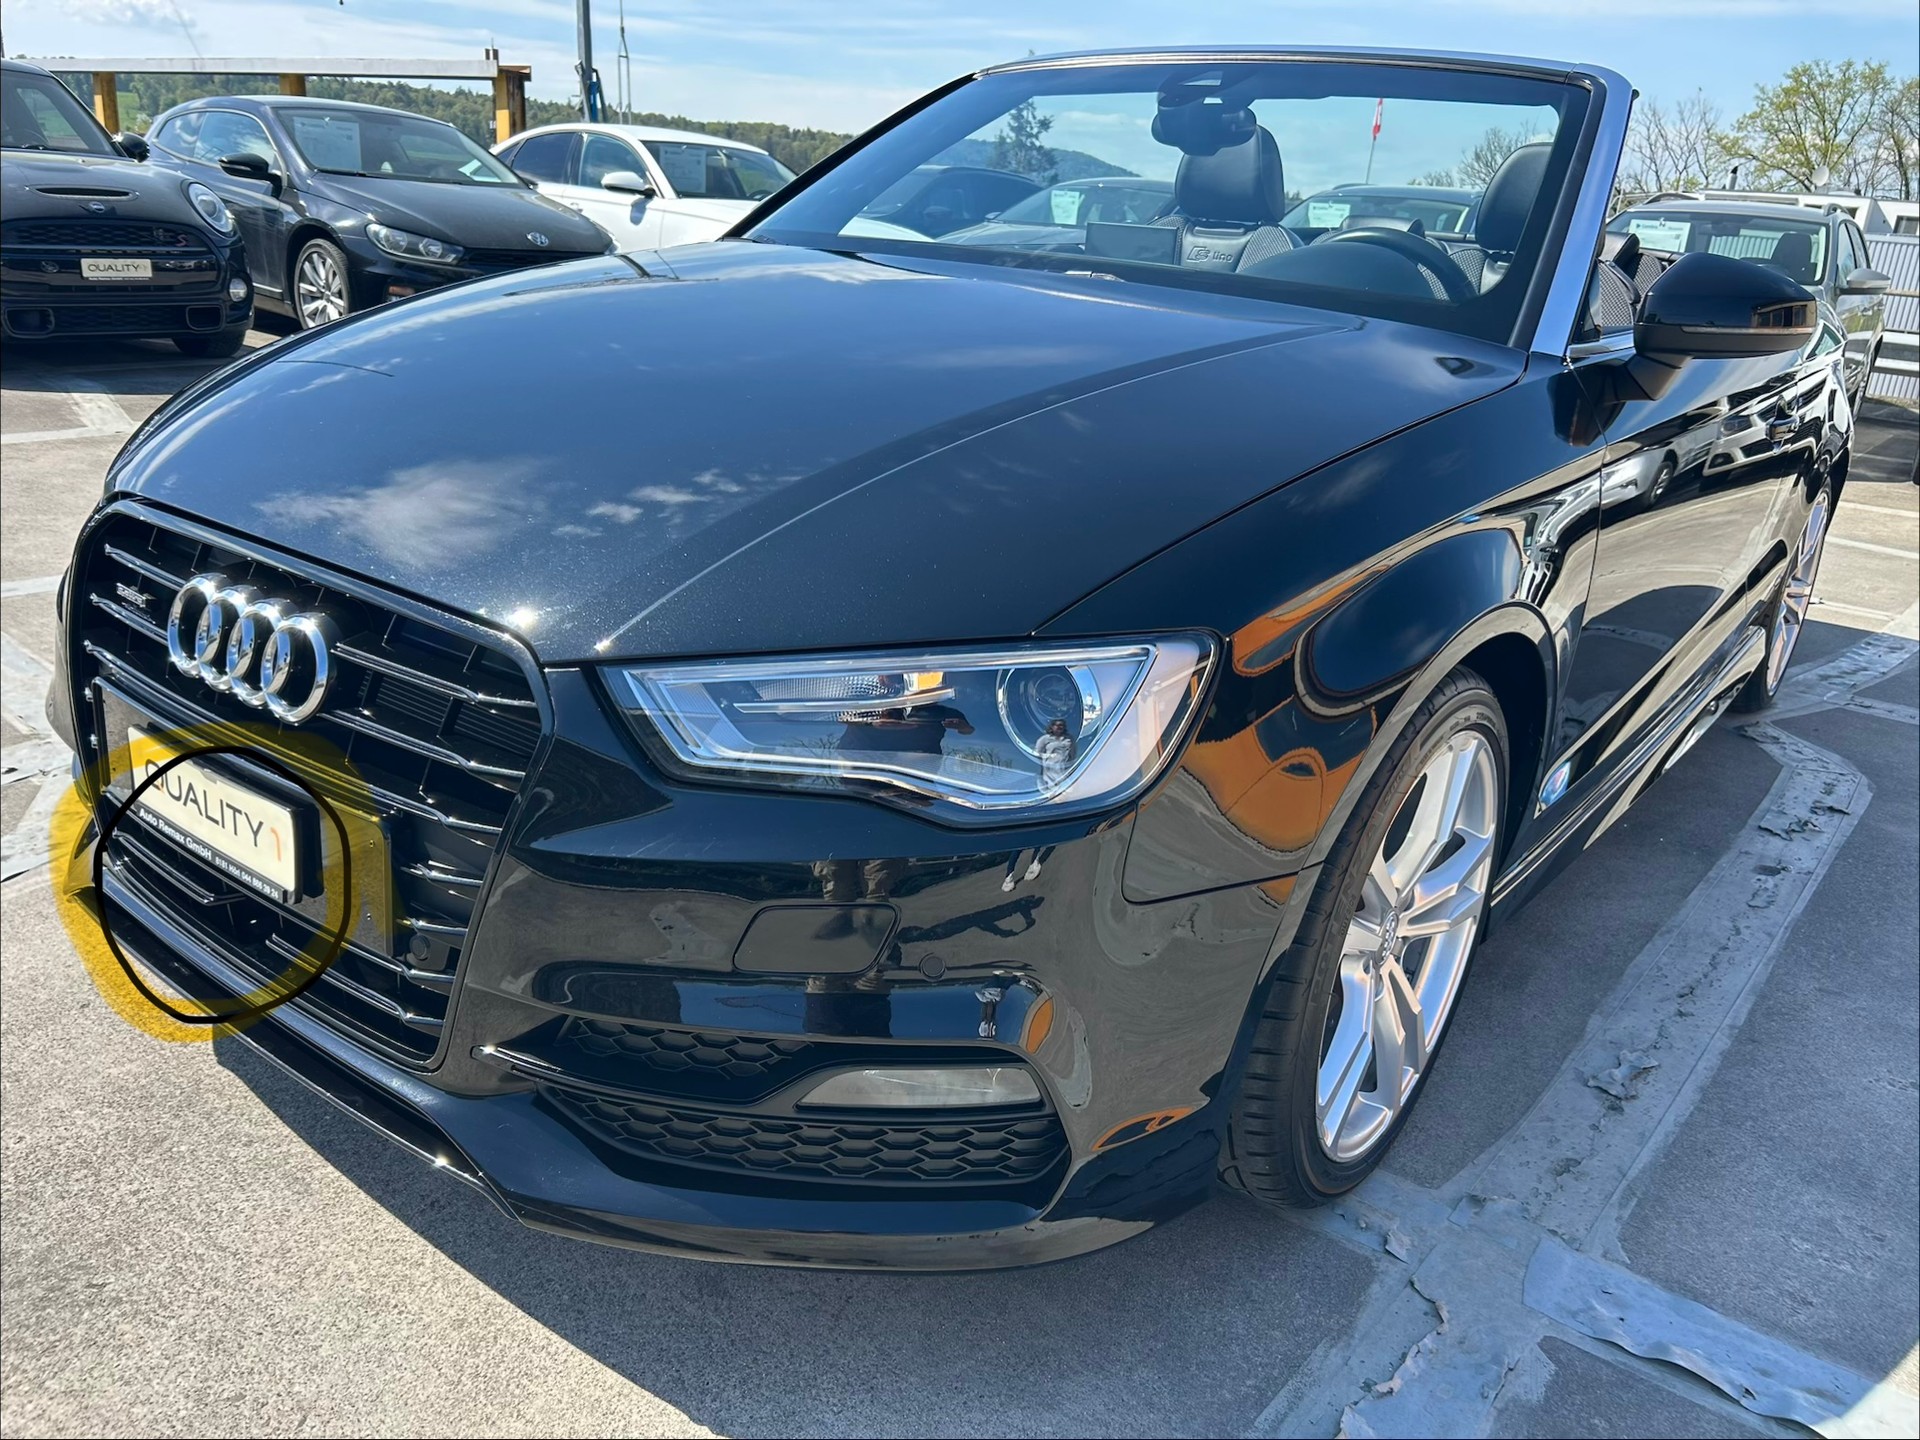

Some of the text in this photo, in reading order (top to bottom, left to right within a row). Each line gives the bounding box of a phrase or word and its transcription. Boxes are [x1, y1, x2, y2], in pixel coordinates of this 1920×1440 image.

[87, 263, 140, 273] QUALITY
[139, 808, 158, 826] Auto
[159, 819, 185, 844] Remax
[186, 837, 212, 861] GmbH
